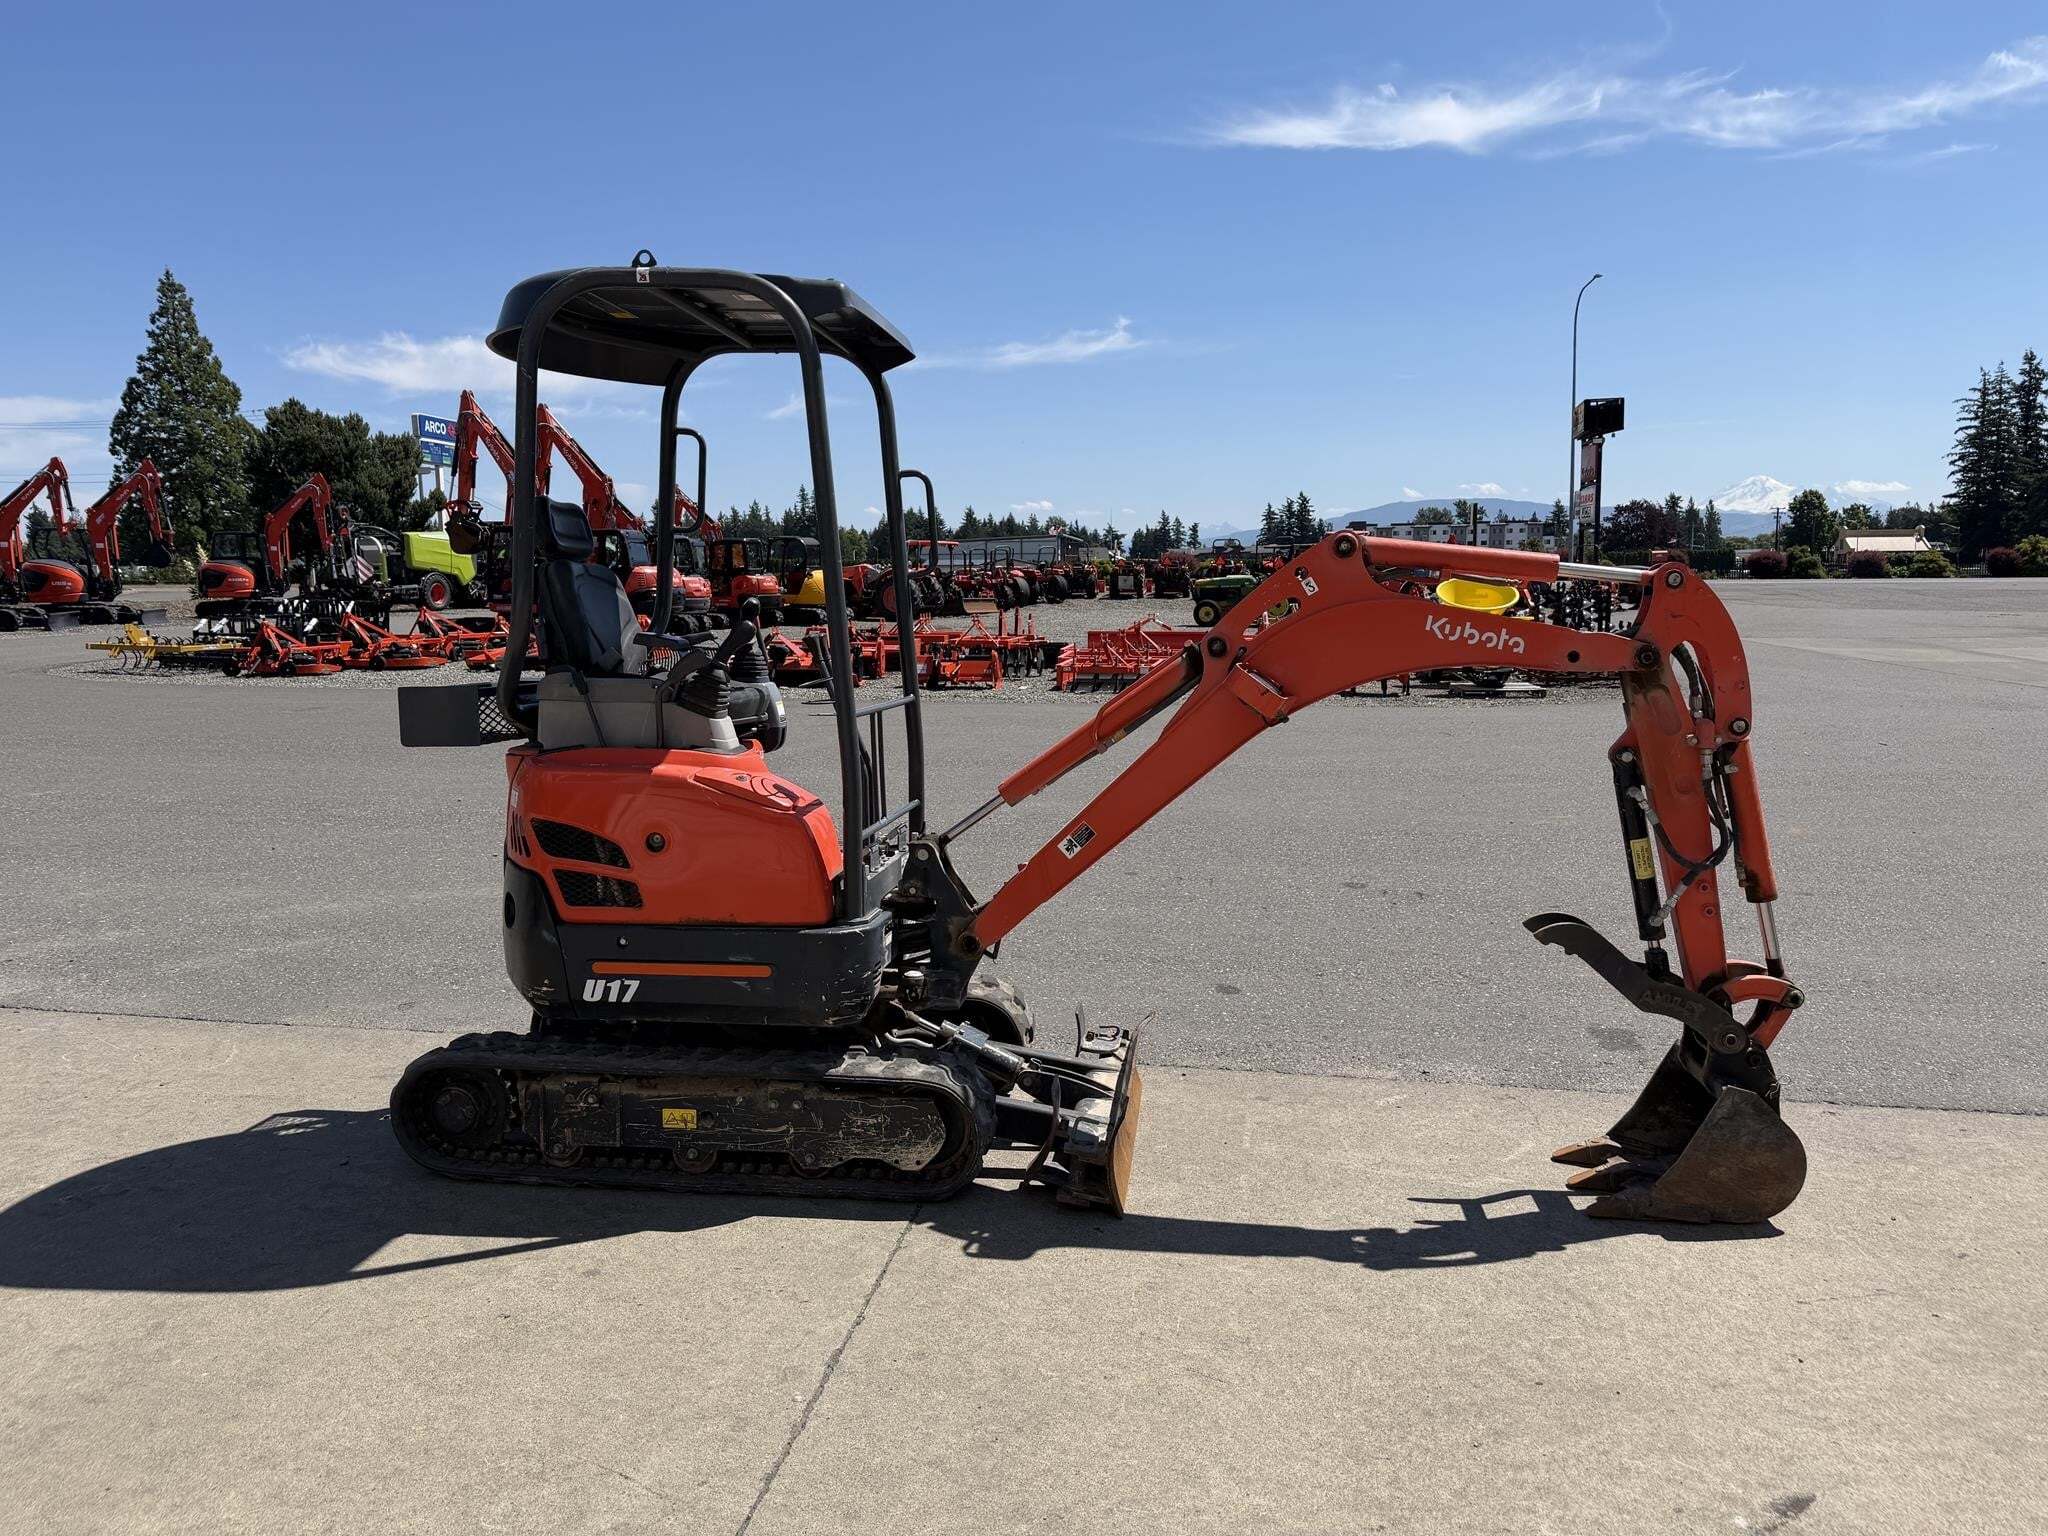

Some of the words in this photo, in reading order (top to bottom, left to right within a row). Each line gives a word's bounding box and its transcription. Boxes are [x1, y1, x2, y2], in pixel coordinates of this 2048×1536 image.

[424, 420, 447, 435] ARCO
[1425, 614, 1525, 654] Kubota
[582, 979, 640, 1003] U17
